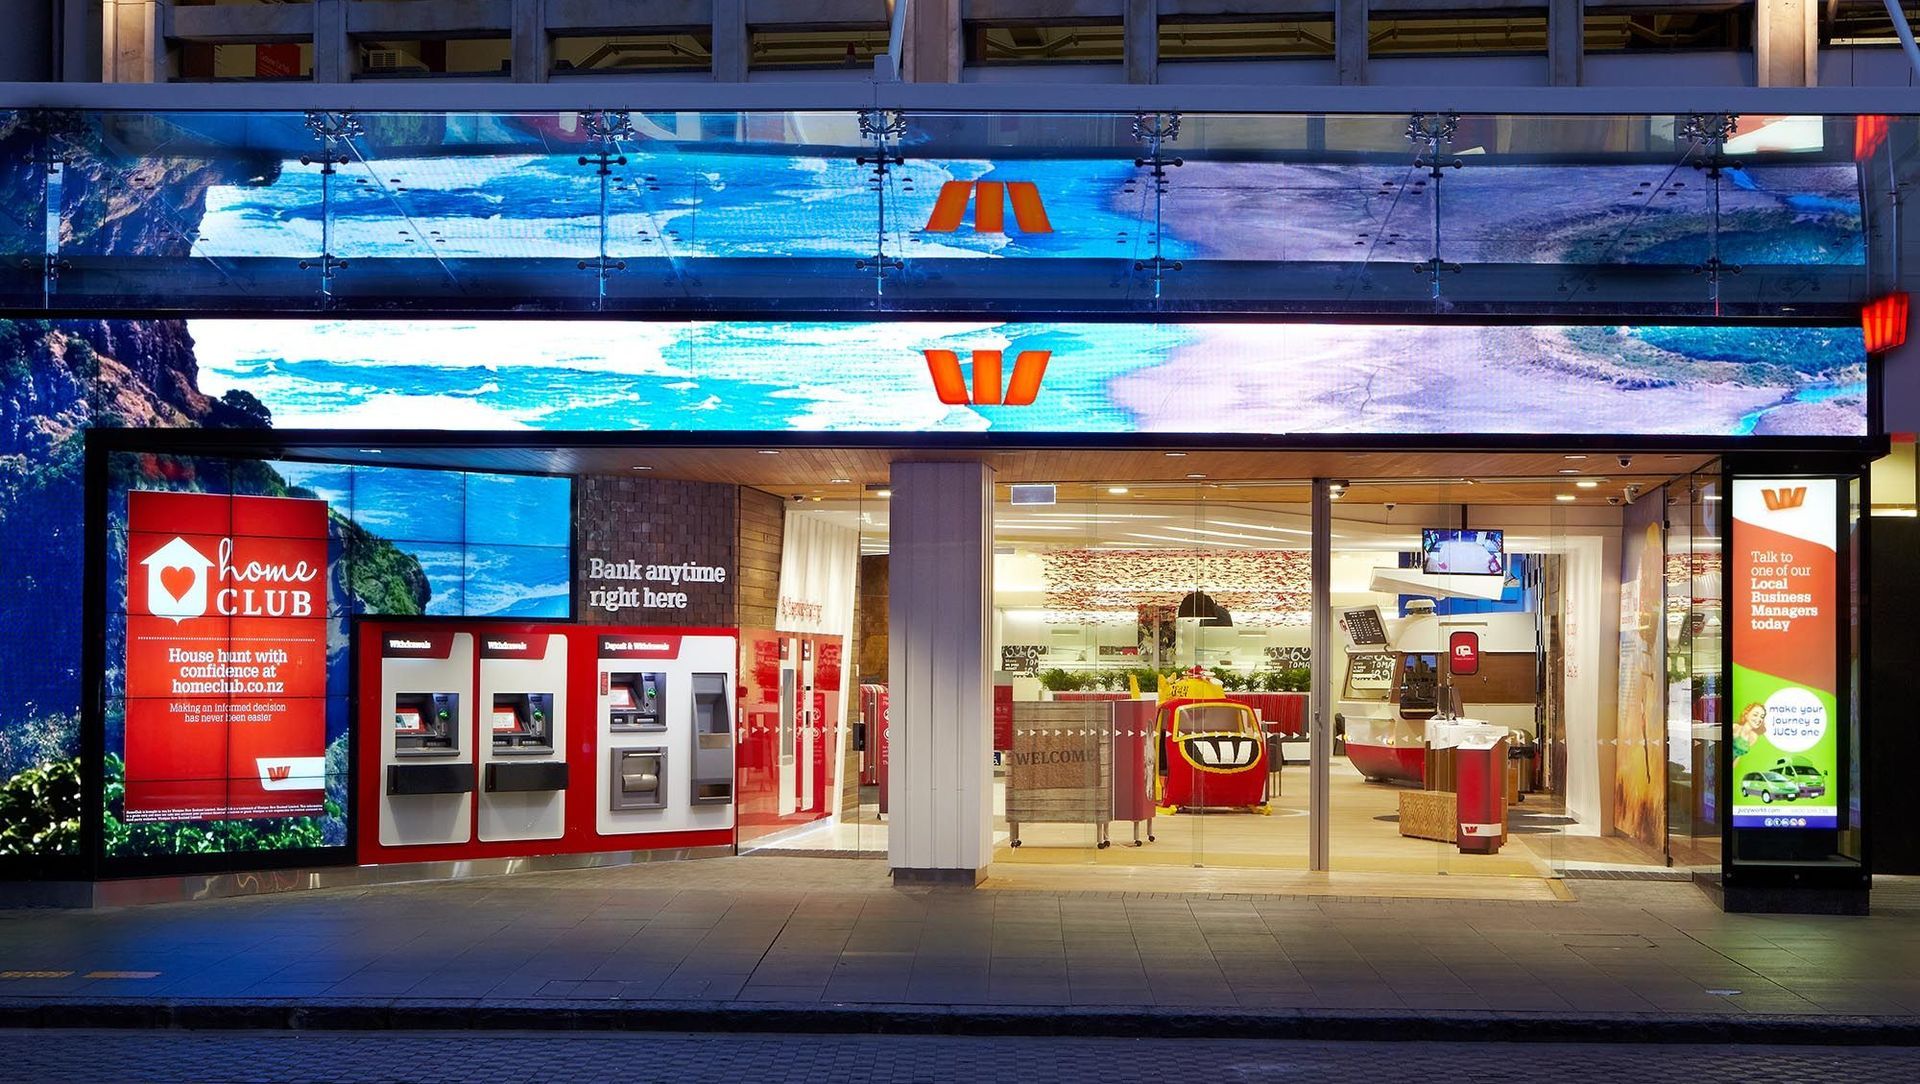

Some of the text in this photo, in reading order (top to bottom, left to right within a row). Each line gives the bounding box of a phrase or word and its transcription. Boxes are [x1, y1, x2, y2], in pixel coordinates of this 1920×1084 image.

[218, 537, 318, 582] home
[1751, 551, 1793, 563] Talk to
[588, 558, 726, 586] Bank anytime
[1751, 565, 1811, 577] one of our
[1751, 577, 1788, 590] Local
[216, 588, 312, 617] CLUB
[589, 585, 688, 612] right here
[1751, 591, 1811, 604] Business
[1751, 604, 1819, 619] Managers
[1751, 619, 1790, 632] today
[168, 648, 288, 663] House hunt with
[180, 664, 277, 678] confidence at
[172, 679, 284, 693] homeclub.co.nz
[170, 702, 286, 714] Making an informed decision
[1769, 705, 1823, 715] make your
[184, 713, 272, 723] has never been easier
[1772, 715, 1820, 727] journey a
